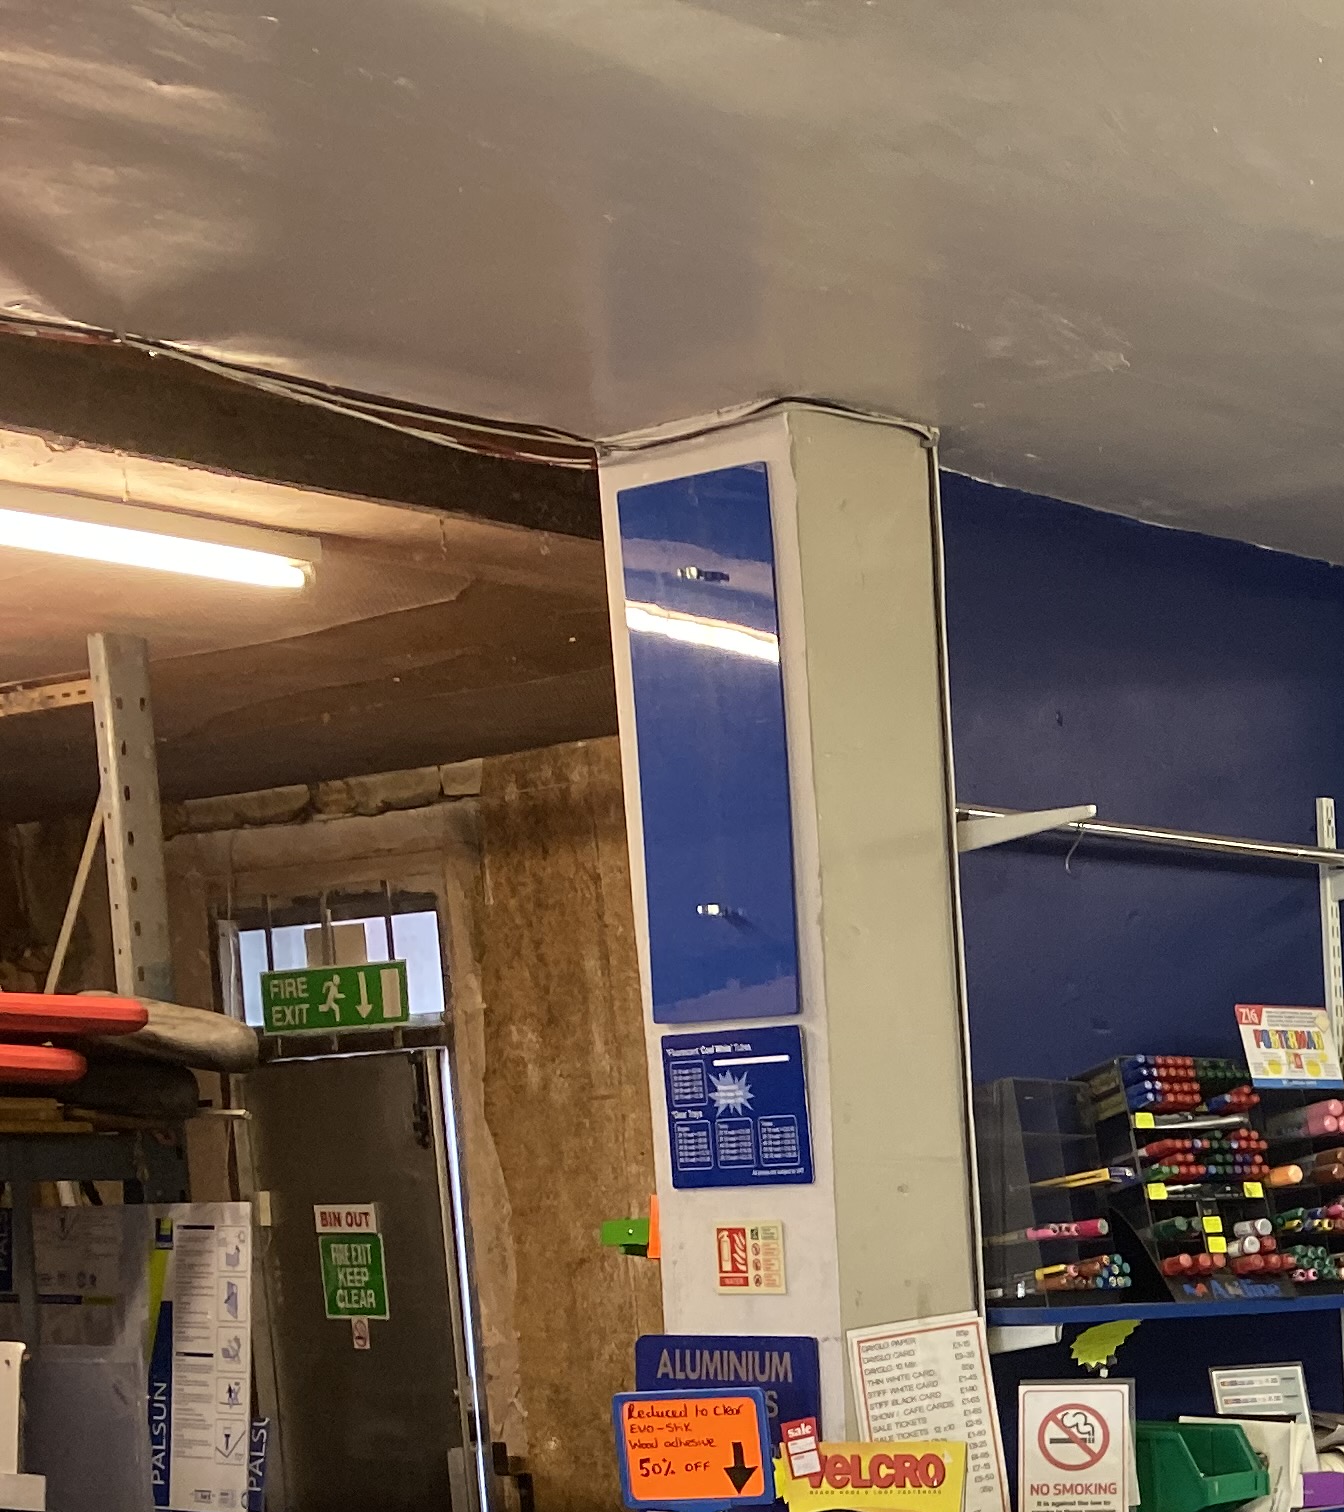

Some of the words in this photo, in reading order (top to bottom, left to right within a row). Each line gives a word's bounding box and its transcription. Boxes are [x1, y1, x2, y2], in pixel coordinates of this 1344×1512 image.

[269, 976, 309, 1000] FIRE
[271, 1003, 311, 1027] EXIT
[320, 1211, 342, 1228] BIN
[345, 1211, 370, 1228] OUT
[337, 1267, 369, 1288] KEEP
[336, 1288, 377, 1309] CLEAR
[656, 1349, 793, 1383] ALUMINIUM
[889, 1384, 914, 1395] WHITE
[915, 1380, 939, 1391] CARD
[919, 1391, 942, 1401] CARD
[627, 1404, 688, 1420] Reduced
[694, 1404, 709, 1417] to
[926, 1400, 955, 1412] CARDS
[787, 1423, 814, 1438] sale
[872, 1423, 892, 1434] SALE
[894, 1416, 928, 1429] TICKETS
[152, 1382, 168, 1486] PALSUN
[629, 1437, 659, 1450] Wood
[664, 1437, 717, 1449] adhesive
[639, 1457, 676, 1478] 50%
[685, 1461, 711, 1473] OFF
[1030, 1483, 1050, 1497] NO
[1053, 1482, 1118, 1496] SMOKING
[1051, 1500, 1076, 1508] against
